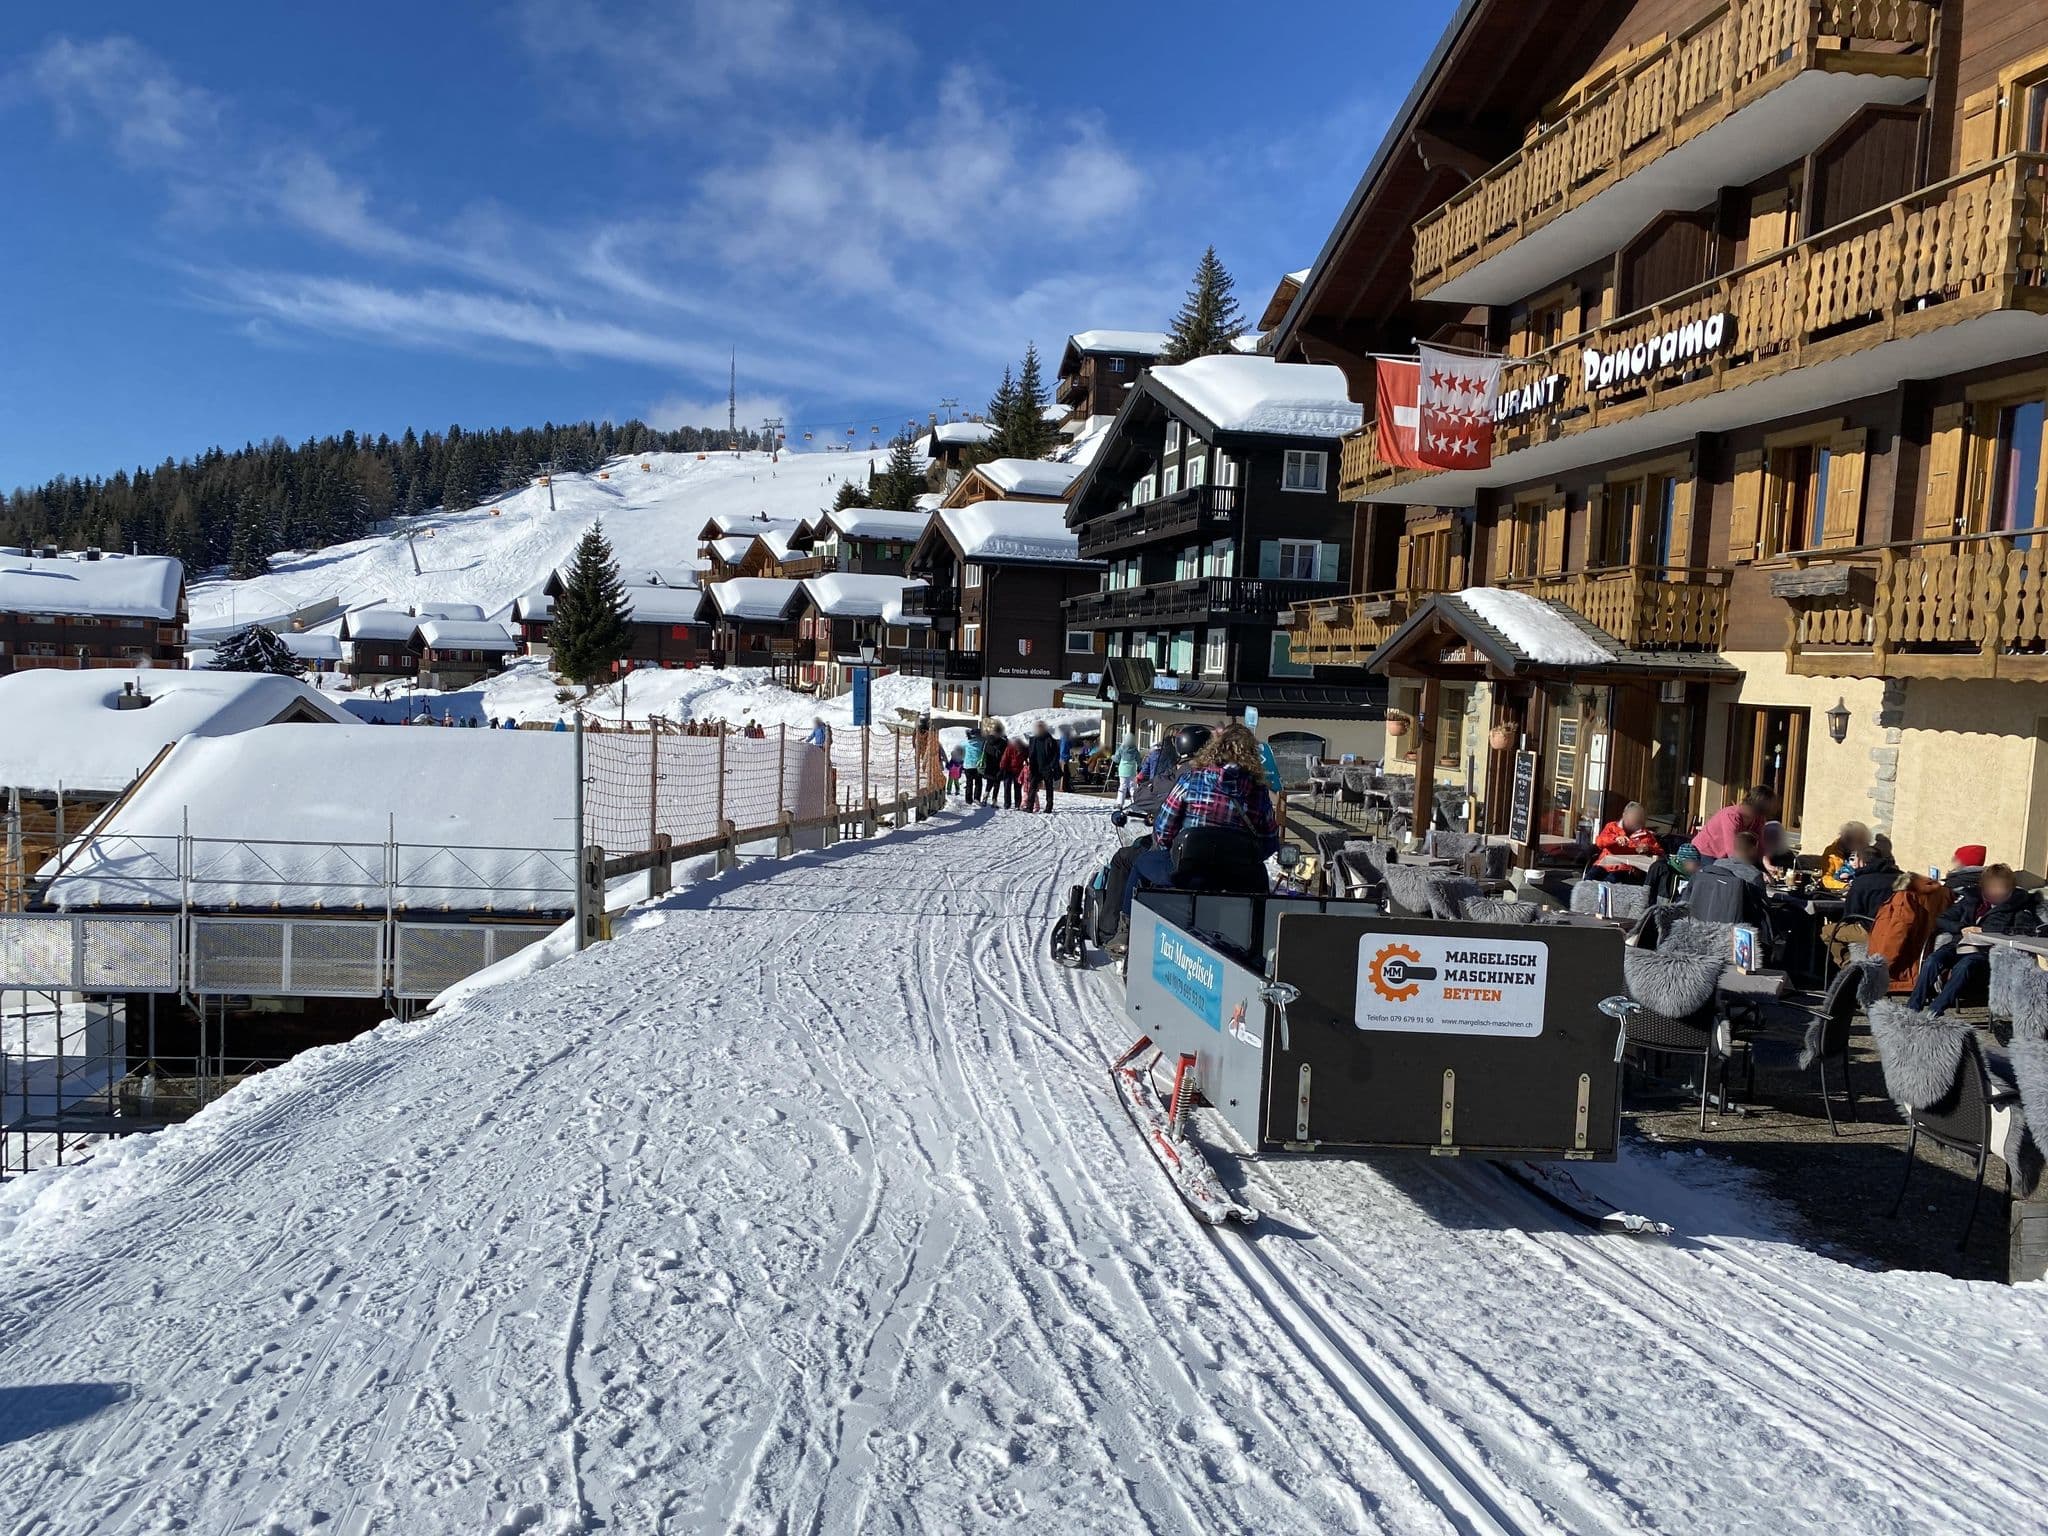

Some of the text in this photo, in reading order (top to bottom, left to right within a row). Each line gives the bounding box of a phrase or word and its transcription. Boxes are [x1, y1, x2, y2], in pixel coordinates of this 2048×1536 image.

[1583, 312, 1725, 392] Panorama
[1160, 932, 1214, 990] Taxi Margelisch
[1445, 950, 1538, 967] MARGELISCH
[1383, 966, 1402, 978] MM
[1444, 969, 1536, 985] MASCHINEN
[1443, 987, 1502, 1002] BETTEN
[1367, 1014, 1389, 1023] Telefon
[1416, 1016, 1424, 1024] 91
[1441, 1018, 1534, 1029] www.margelisch-maschinen.ch
